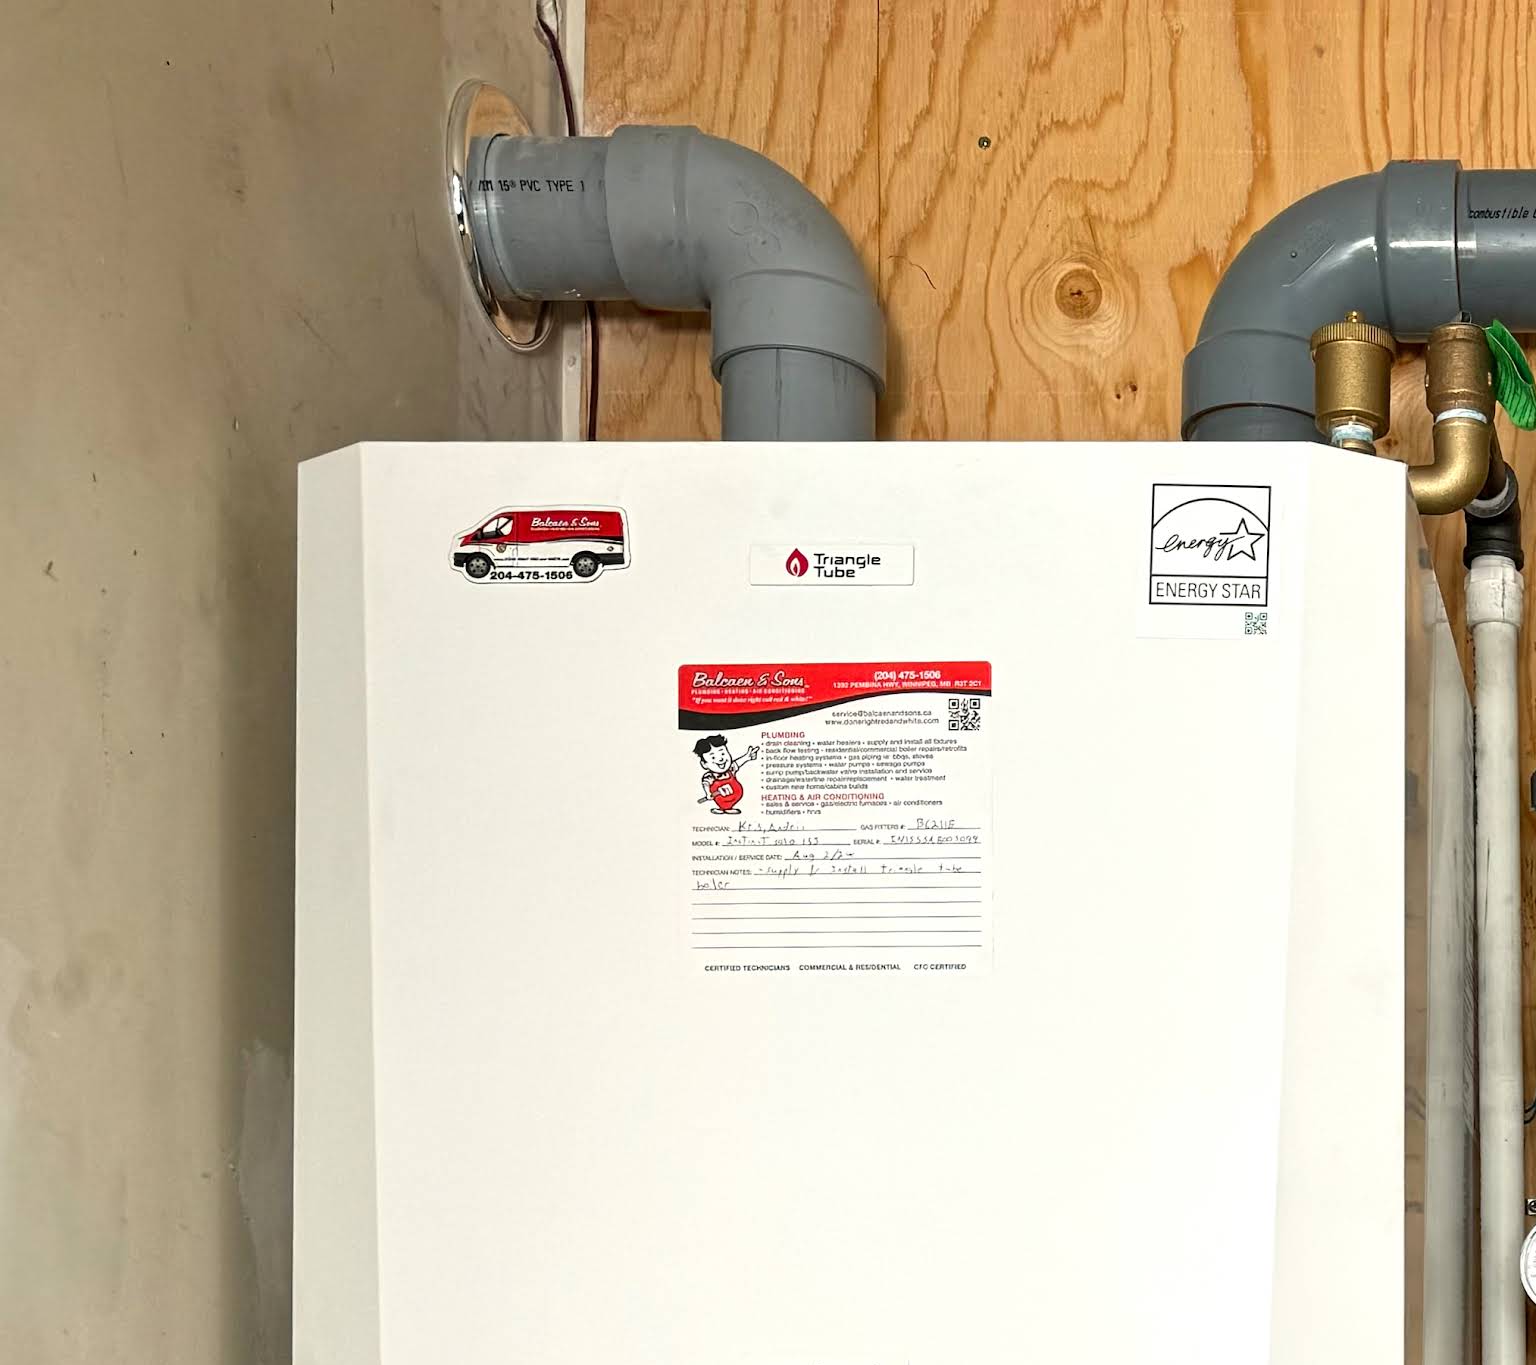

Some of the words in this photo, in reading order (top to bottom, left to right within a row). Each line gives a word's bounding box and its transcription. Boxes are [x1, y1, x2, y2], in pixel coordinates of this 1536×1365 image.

[520, 180, 541, 192] PVC
[546, 180, 574, 192] TYPE
[580, 180, 585, 192] 1
[1469, 206, 1530, 219] combustible
[531, 518, 570, 528] Balcaen
[579, 517, 600, 528] Sons
[1155, 534, 1242, 561] energy
[813, 553, 881, 569] Triangle
[813, 566, 856, 578] Tube
[1156, 582, 1218, 599] ENERGY
[1222, 584, 1261, 600] STAR
[693, 672, 754, 687] Balcaen
[757, 672, 770, 687] &
[771, 671, 805, 687] Sons
[874, 671, 897, 681] (204)
[898, 671, 941, 680] 475-1506
[705, 964, 741, 972] CERTIFIED
